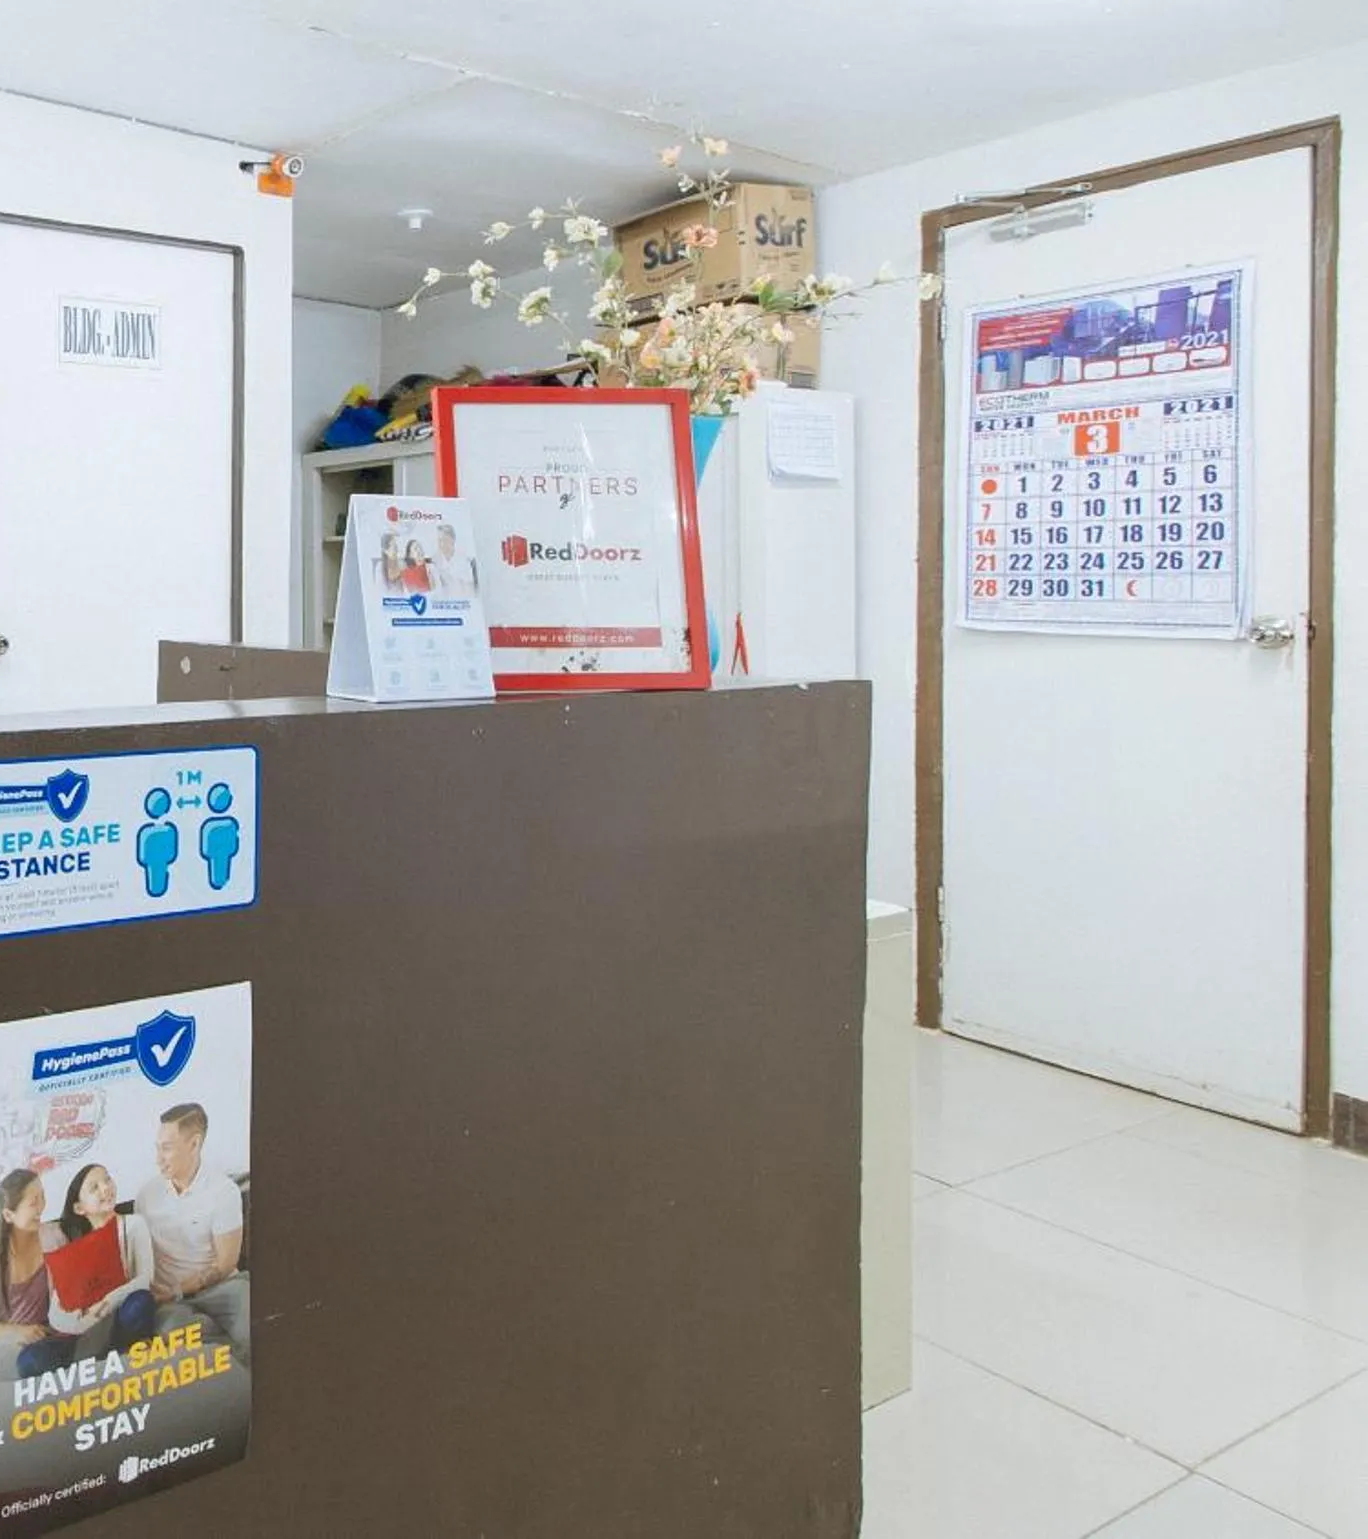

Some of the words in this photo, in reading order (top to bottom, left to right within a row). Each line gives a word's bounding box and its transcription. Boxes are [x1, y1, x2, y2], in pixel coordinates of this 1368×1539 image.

[756, 214, 806, 248] Surf
[643, 239, 686, 270] Su
[1181, 329, 1228, 351] 2021
[1057, 407, 1140, 424] MARCH
[1086, 424, 1108, 454] 3
[1018, 477, 1027, 493] 1
[1052, 475, 1063, 492] 2
[1088, 472, 1100, 490] 3
[1125, 470, 1138, 488] 4
[1164, 467, 1176, 485] 5
[1203, 465, 1217, 483] 6
[982, 503, 991, 520] 7
[1016, 502, 1028, 519] 8
[1051, 501, 1063, 518] 9
[1084, 499, 1105, 517] 10
[1124, 497, 1141, 515] 11
[1159, 496, 1181, 514] 12
[1199, 493, 1223, 512] 13
[976, 529, 996, 546] 14
[1011, 528, 1032, 545] 15
[1047, 527, 1068, 544] 16
[1084, 526, 1104, 543] 17
[1121, 524, 1143, 542] 18
[1160, 523, 1182, 541] 19
[1196, 522, 1224, 541] 20
[530, 541, 642, 561] RedDoorz
[976, 554, 996, 571] 21
[1009, 553, 1032, 571] 22
[1044, 553, 1068, 570] 23
[1080, 552, 1104, 570] 24
[1117, 552, 1144, 570] 25
[1156, 551, 1183, 569] 26
[1197, 551, 1222, 569] 27
[974, 580, 997, 597] 28
[1008, 580, 1033, 597] 29
[1043, 579, 1068, 597] 30
[1081, 579, 1104, 597] 31
[177, 771, 183, 786] 1
[188, 770, 202, 785] M
[38, 830, 54, 851] A
[60, 823, 121, 848] SAFE
[41, 1044, 132, 1072] HygienePass
[14, 1356, 96, 1407] HAVE
[102, 1350, 125, 1380] A
[127, 1323, 202, 1370] SAFE
[11, 1345, 232, 1440] COMFORTABLE
[75, 1404, 151, 1451] STAY
[1, 1491, 53, 1518] Officially
[54, 1474, 107, 1501] certified:
[139, 1437, 216, 1473] RedDoorz
